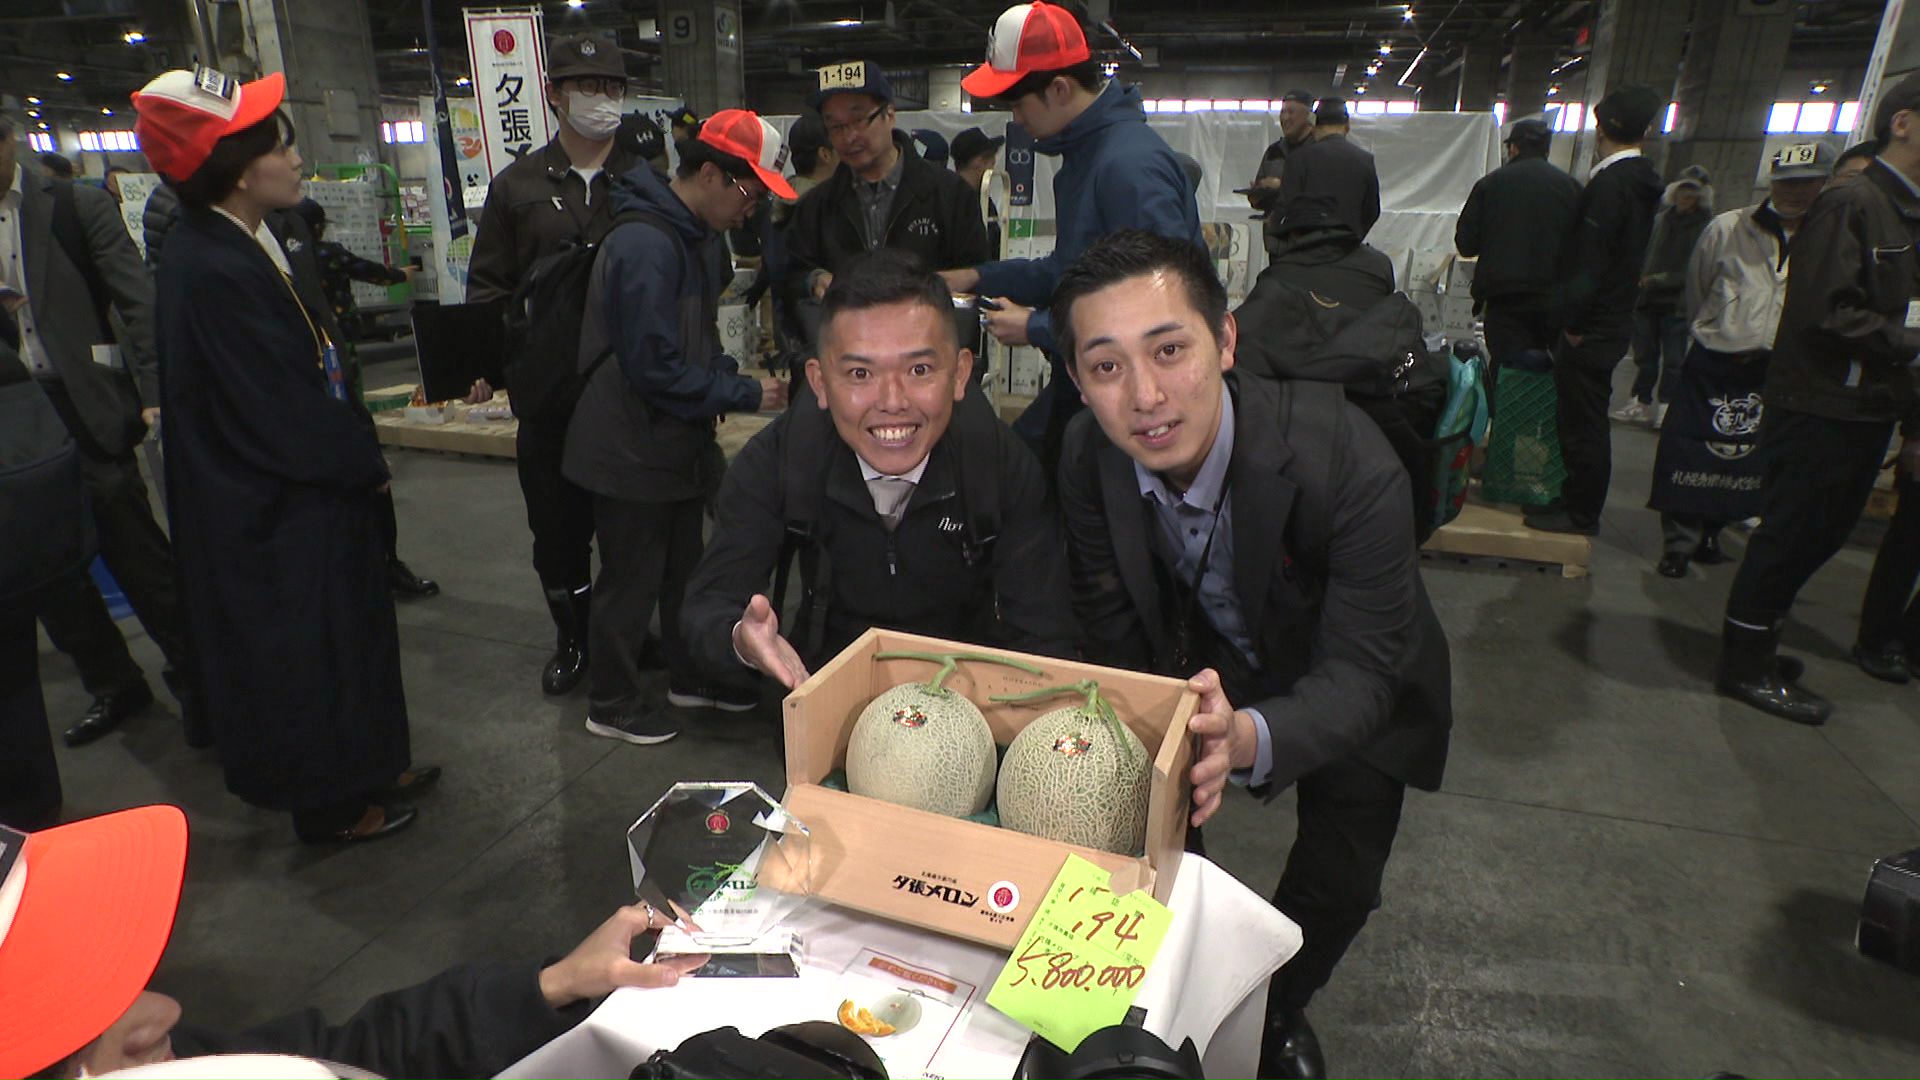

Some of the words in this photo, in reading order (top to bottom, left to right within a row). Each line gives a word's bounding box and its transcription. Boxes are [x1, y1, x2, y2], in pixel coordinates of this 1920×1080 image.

[674, 16, 690, 38] 9
[893, 874, 979, 908] 夕張メロン
